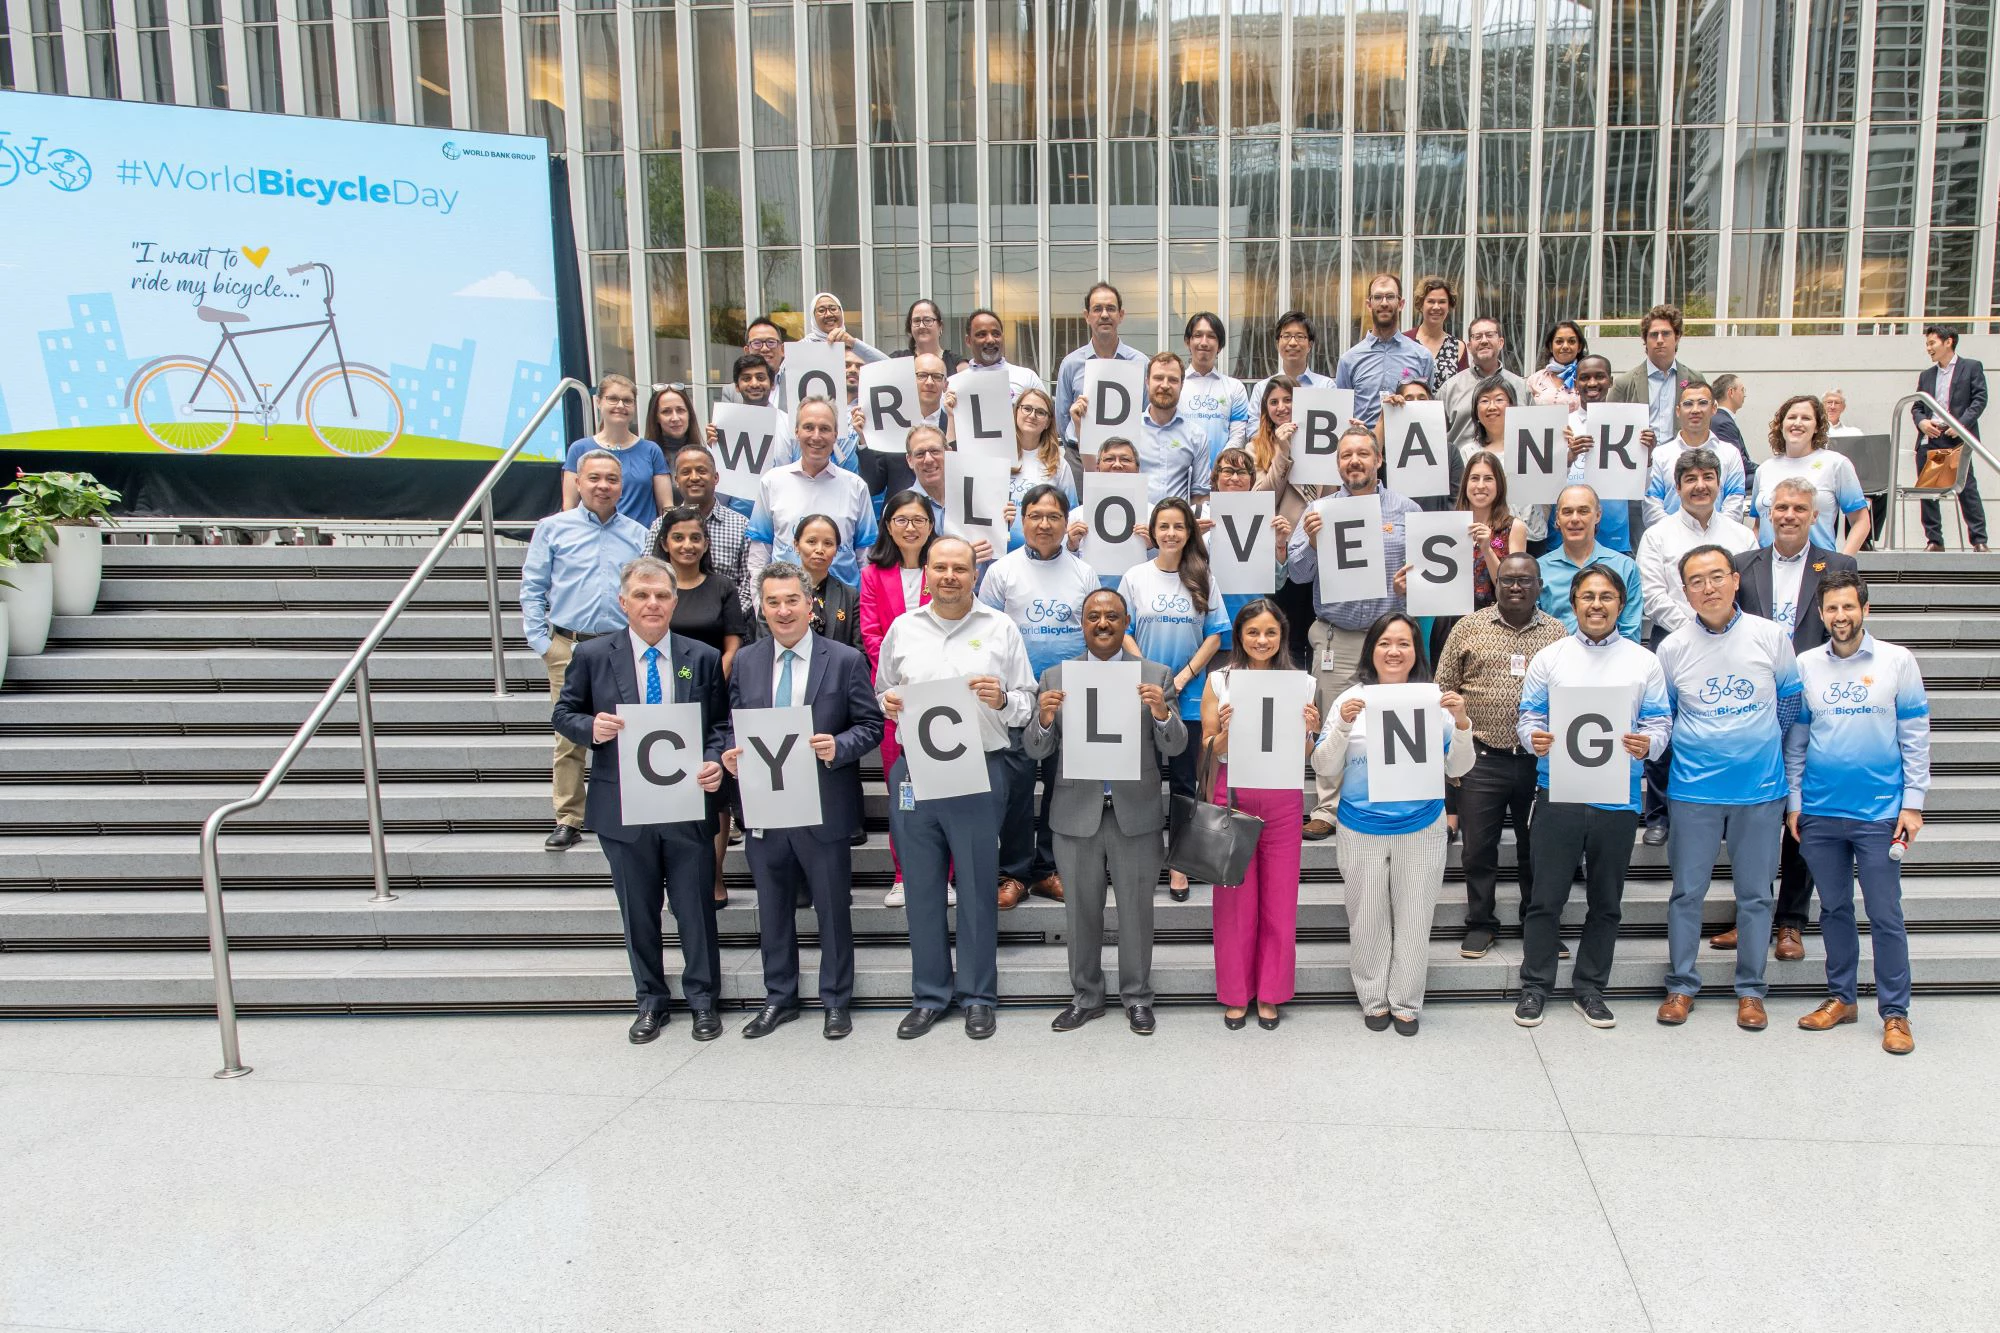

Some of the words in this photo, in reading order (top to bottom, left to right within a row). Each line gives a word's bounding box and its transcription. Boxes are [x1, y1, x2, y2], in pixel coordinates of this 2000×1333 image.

[463, 148, 490, 158] WORLD
[490, 151, 511, 159] BANK
[511, 153, 536, 161] GROUP
[117, 159, 459, 214] #WorldBicycleDay
[160, 247, 214, 269] want
[219, 248, 238, 270] to
[131, 269, 171, 292] ride
[176, 279, 207, 307] my
[797, 370, 837, 403] O
[870, 385, 912, 431] R
[1095, 380, 1131, 426] D
[969, 393, 1003, 439] L
[1305, 409, 1340, 455] B
[714, 428, 774, 475] W
[1396, 422, 1438, 469] A
[1517, 428, 1554, 475] N
[1598, 424, 1637, 470] K
[963, 476, 993, 527] L
[1094, 495, 1136, 544] O
[1221, 514, 1265, 562] V
[1334, 519, 1368, 570] E
[1421, 534, 1458, 584] S
[918, 705, 968, 762] C
[1086, 687, 1122, 744] L
[1261, 697, 1274, 753] I
[1382, 708, 1427, 765] N
[636, 729, 688, 786] C
[747, 733, 800, 792] Y
[1566, 713, 1614, 768] G
